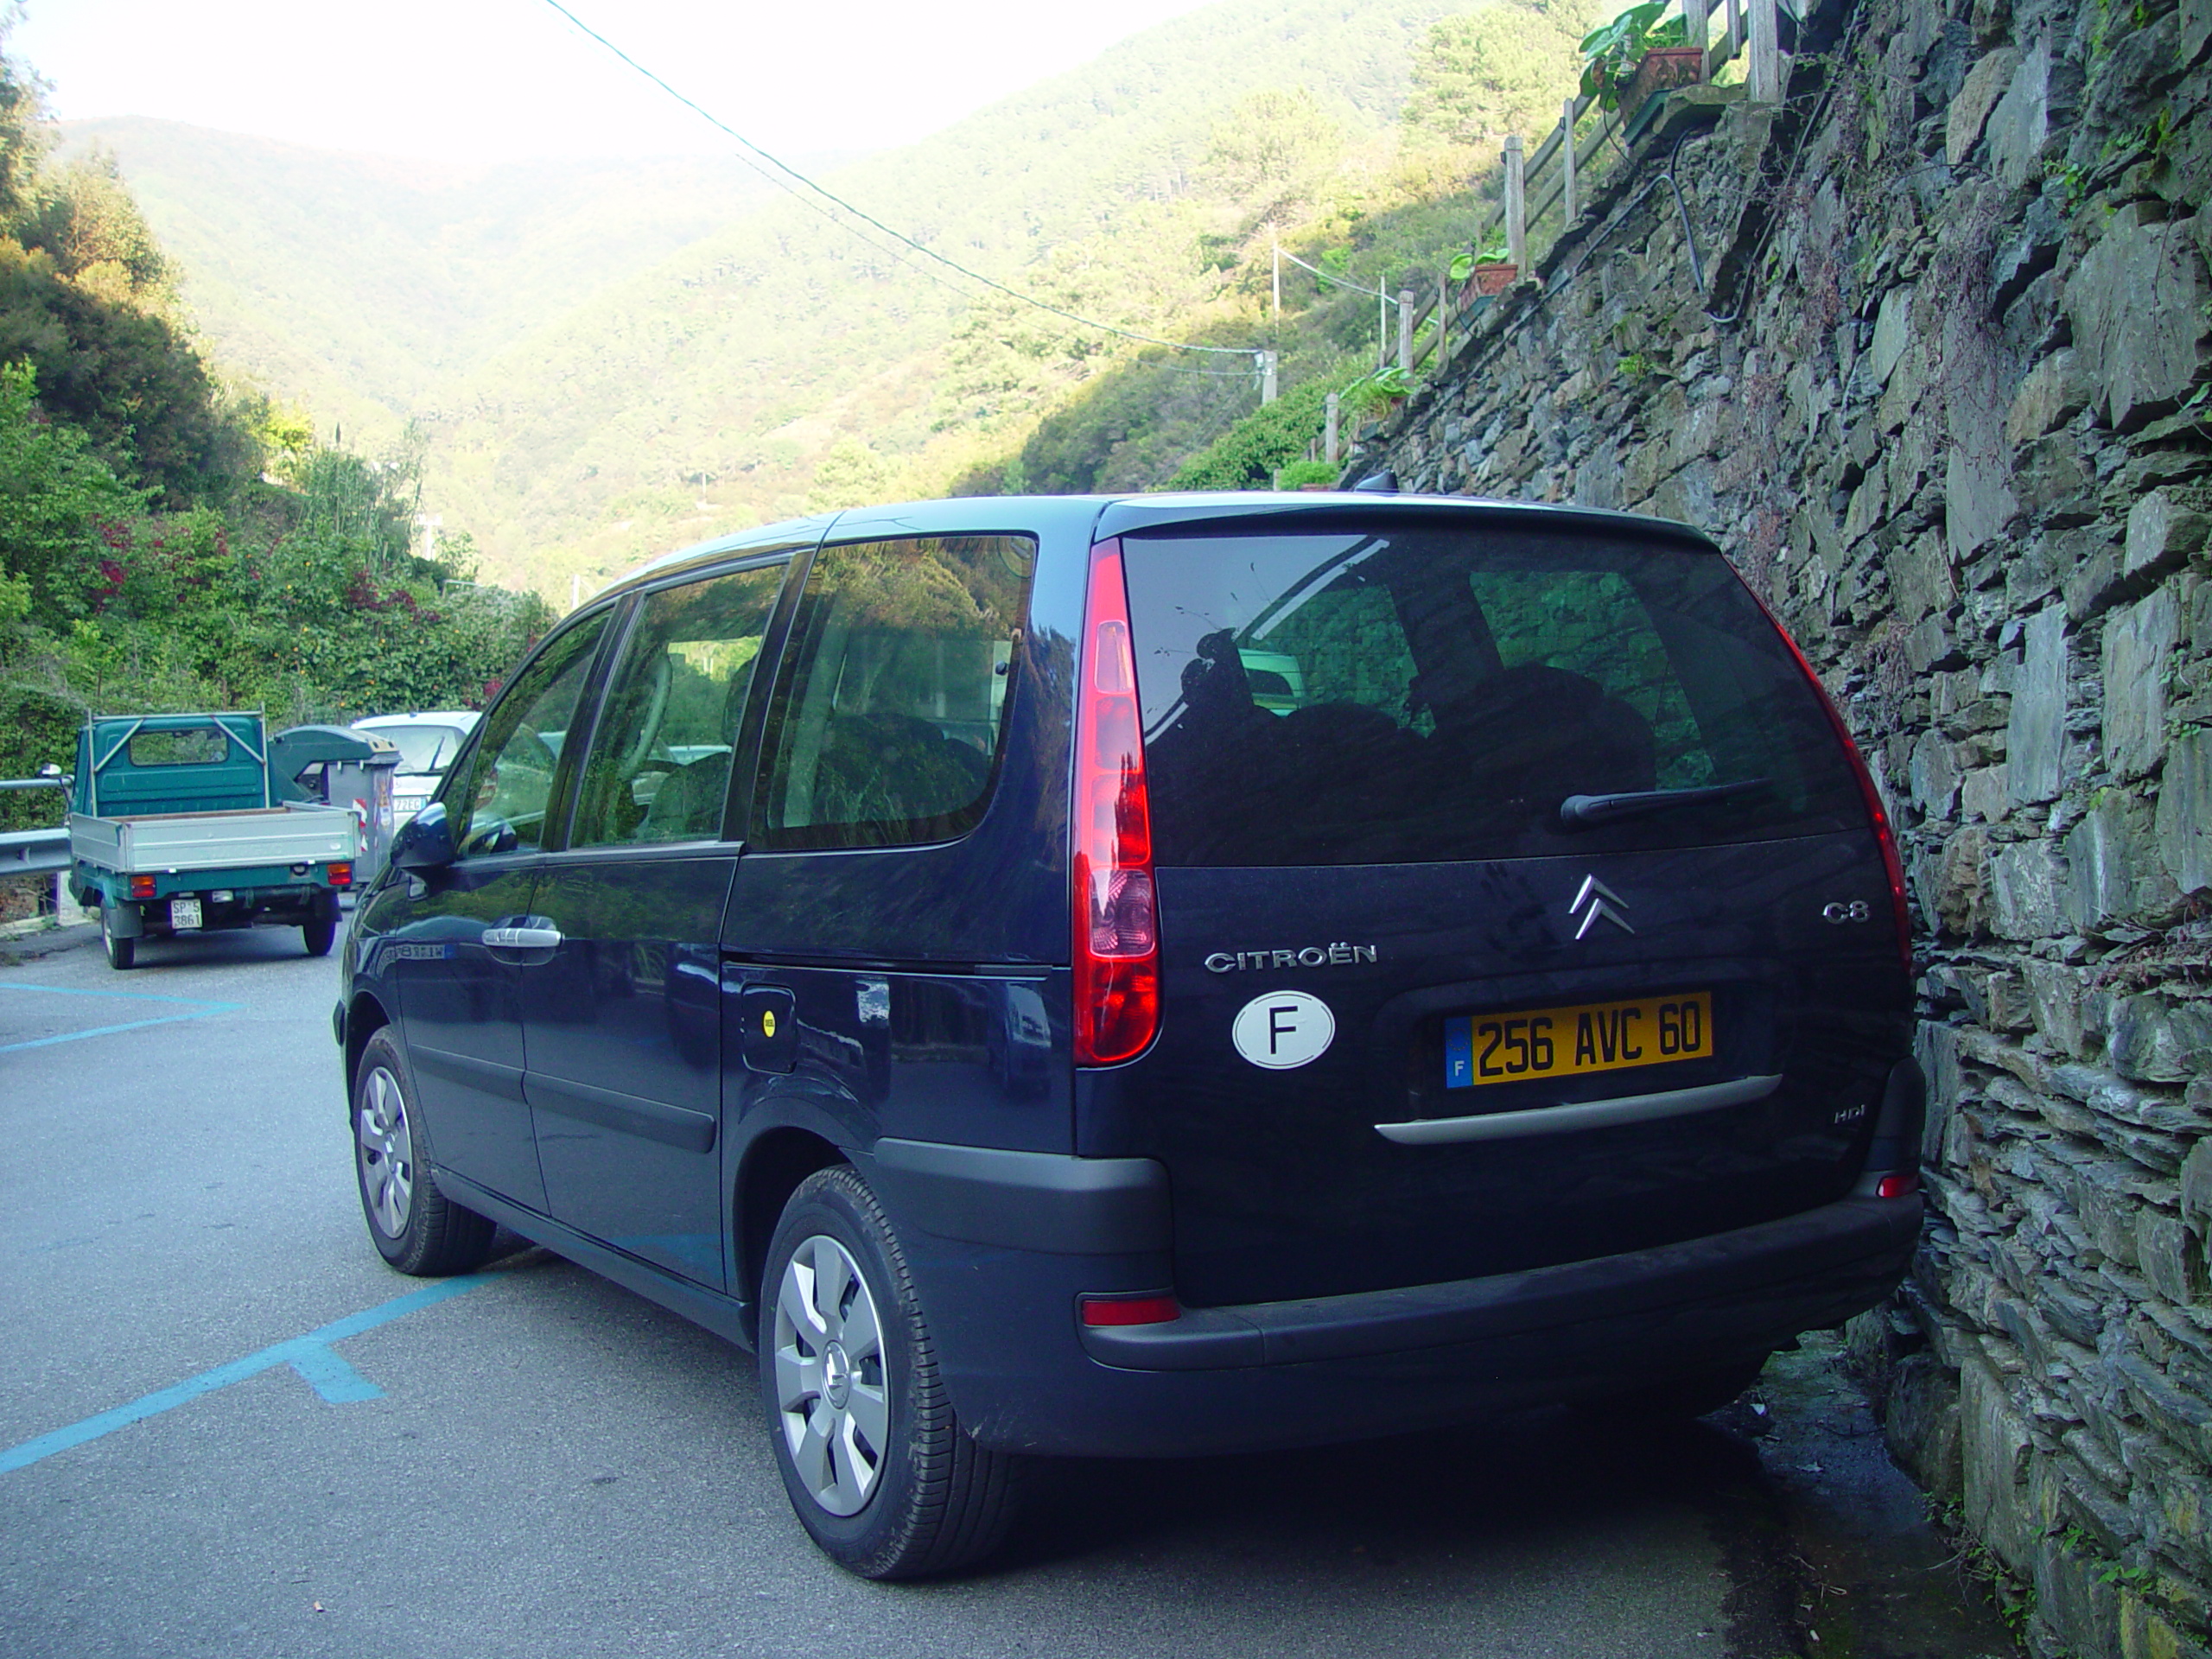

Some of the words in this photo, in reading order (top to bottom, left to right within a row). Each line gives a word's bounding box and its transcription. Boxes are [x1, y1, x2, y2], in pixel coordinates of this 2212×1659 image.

[173, 902, 186, 914] SP
[174, 914, 200, 927] 3861
[1821, 899, 1871, 925] C8
[1205, 942, 1377, 973] CITROËN
[1269, 1006, 1298, 1054] F
[1454, 1060, 1465, 1077] F
[1478, 1017, 1554, 1077] 256
[1574, 1007, 1642, 1066] AVC
[1659, 1001, 1701, 1055] 60
